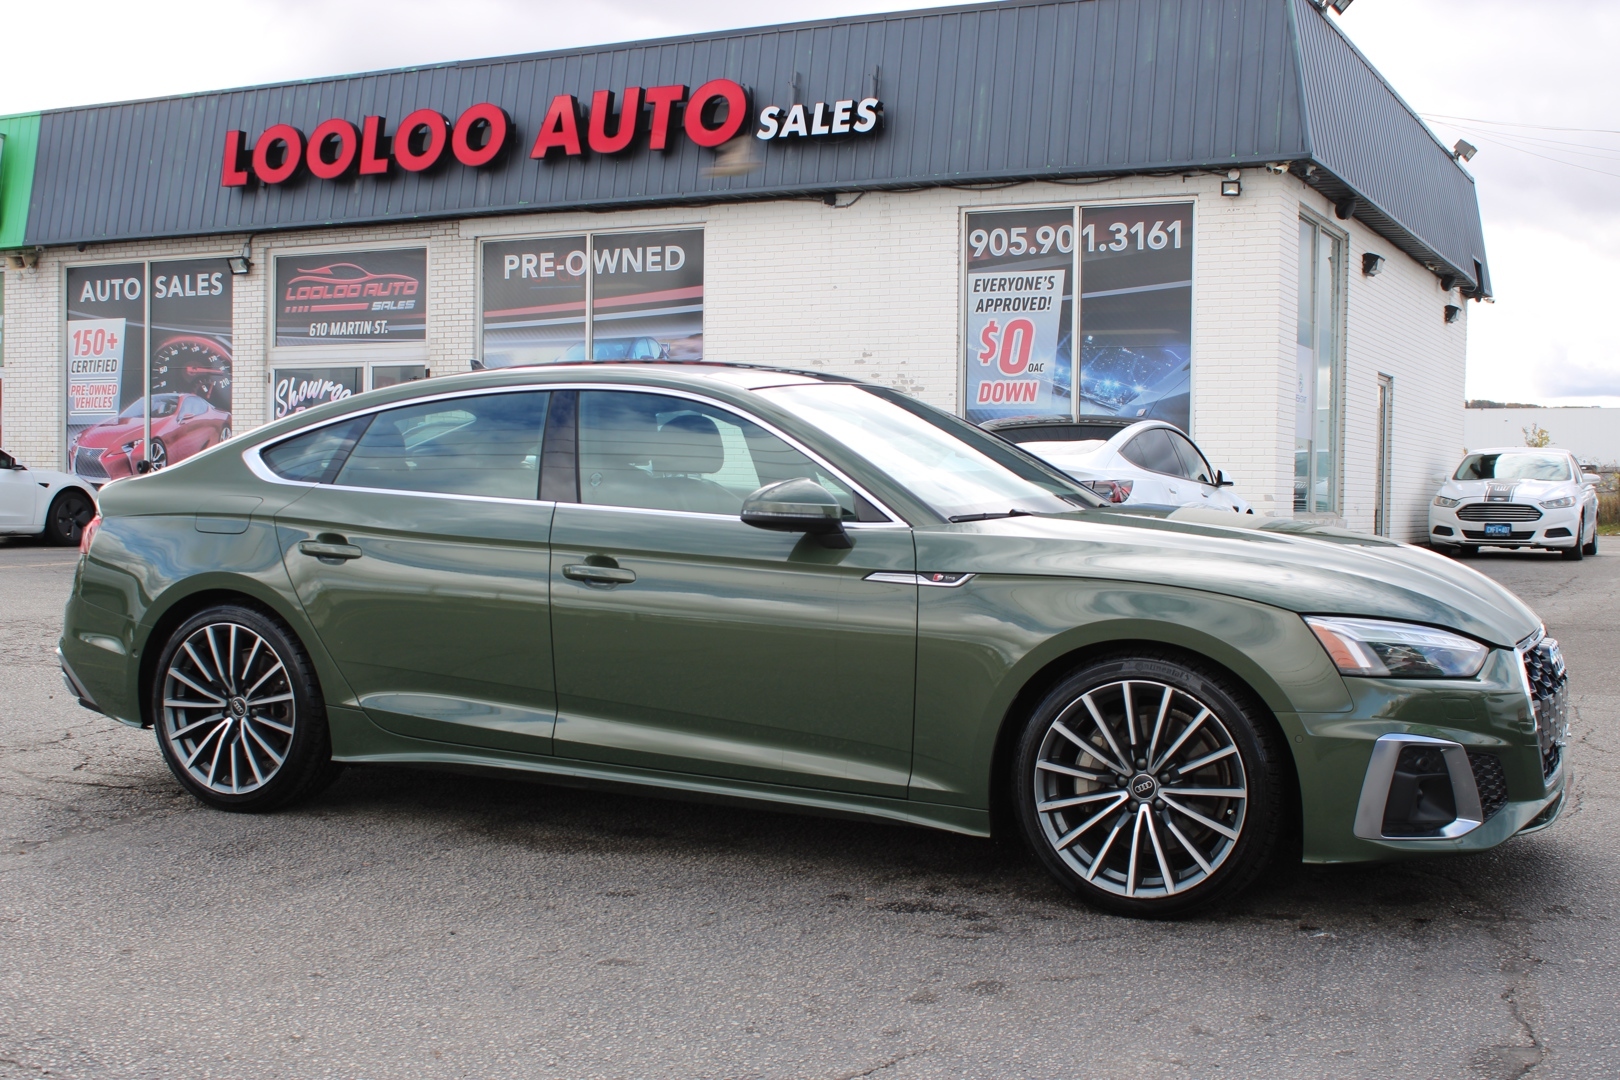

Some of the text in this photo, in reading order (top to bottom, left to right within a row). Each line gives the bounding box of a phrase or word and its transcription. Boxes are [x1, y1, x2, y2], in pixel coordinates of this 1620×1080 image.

[222, 78, 880, 188] LOOLOO AUTO SALES
[969, 220, 1183, 258] 905.901.3161
[504, 245, 686, 280] PRE-OWNED
[80, 272, 223, 303] AUTO SALES
[285, 281, 419, 301] LOOLOO AUTO
[973, 275, 1055, 293] EVERYONE'S
[371, 300, 415, 311] SALES
[975, 296, 1052, 313] APPROVED!
[309, 320, 389, 337] 610 MARTIN ST.
[73, 328, 118, 356] 150+
[979, 318, 1044, 375] $0 OAC
[71, 359, 118, 373] CERTIFIED
[71, 384, 118, 396] PRE-OWNED
[978, 382, 1038, 403] DOWN
[75, 397, 113, 409] VEHICLES
